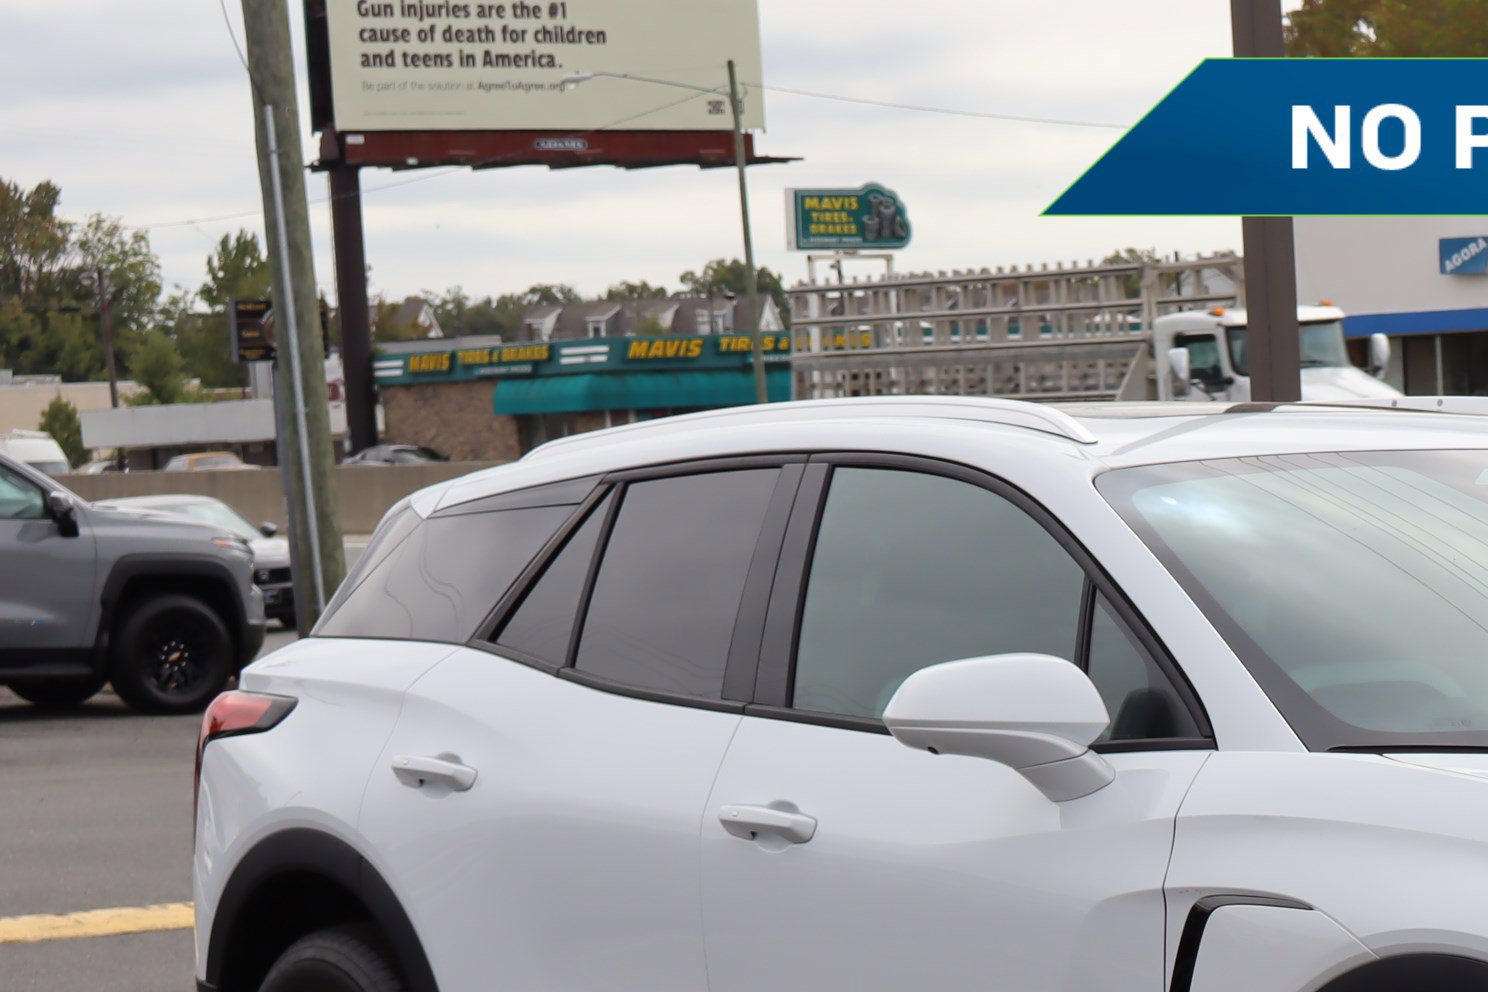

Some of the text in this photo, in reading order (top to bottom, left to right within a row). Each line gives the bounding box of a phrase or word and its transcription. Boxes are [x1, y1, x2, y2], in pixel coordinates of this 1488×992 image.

[357, 0, 567, 22] Gun injuries are the #1
[359, 25, 607, 44] cause of death for children
[361, 50, 563, 68] and teens in America.
[804, 197, 858, 210] MAVIS
[1444, 238, 1487, 272] AGORA
[627, 338, 703, 359] MAVIS
[778, 337, 790, 350] &
[408, 352, 450, 373] MAVIS
